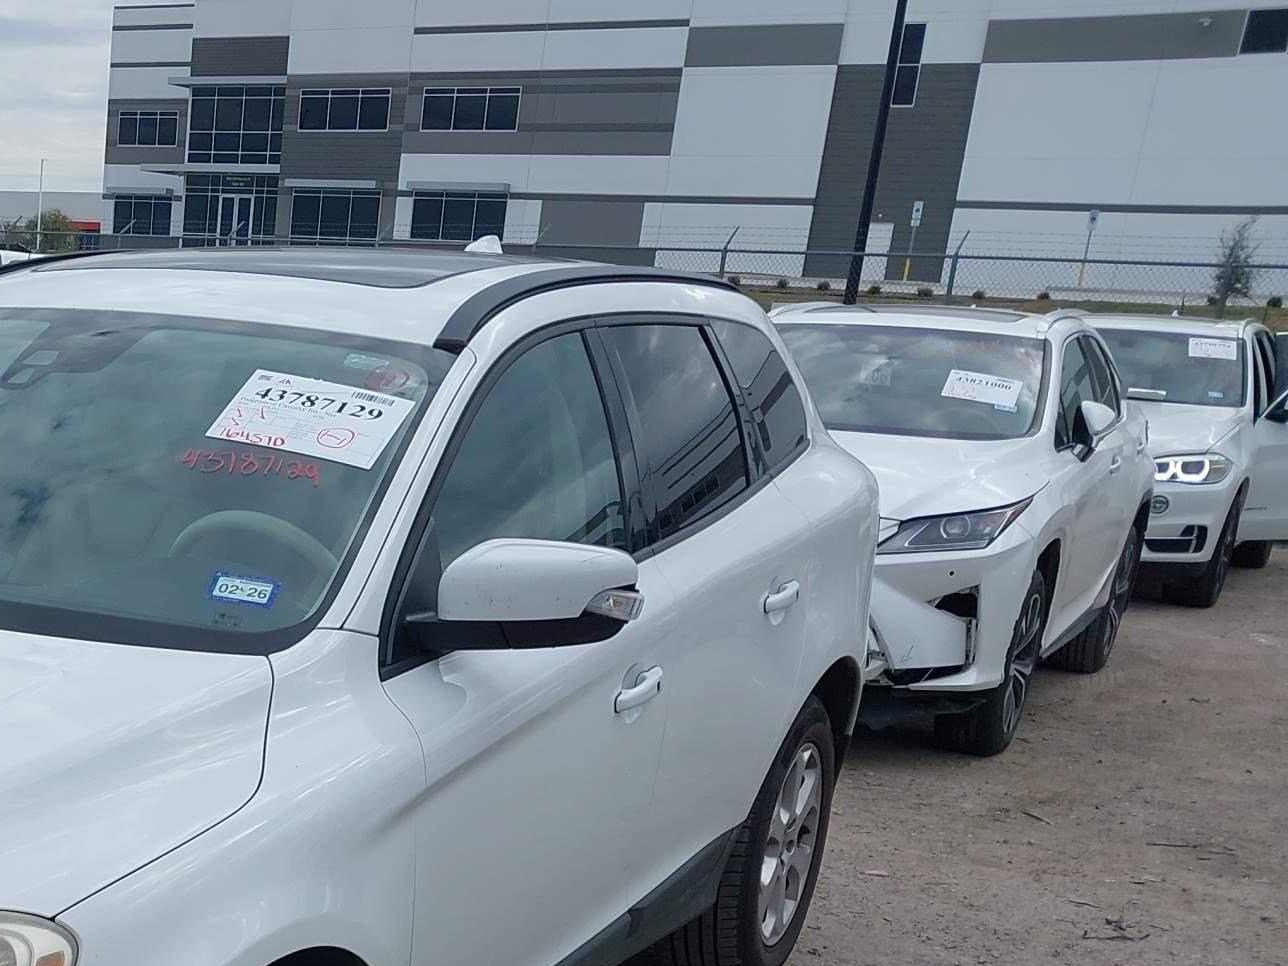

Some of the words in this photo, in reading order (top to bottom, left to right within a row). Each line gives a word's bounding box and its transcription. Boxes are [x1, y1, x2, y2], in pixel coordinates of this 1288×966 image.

[255, 387, 383, 421] 43787129
[218, 583, 239, 594] 02
[247, 587, 269, 599] 26
